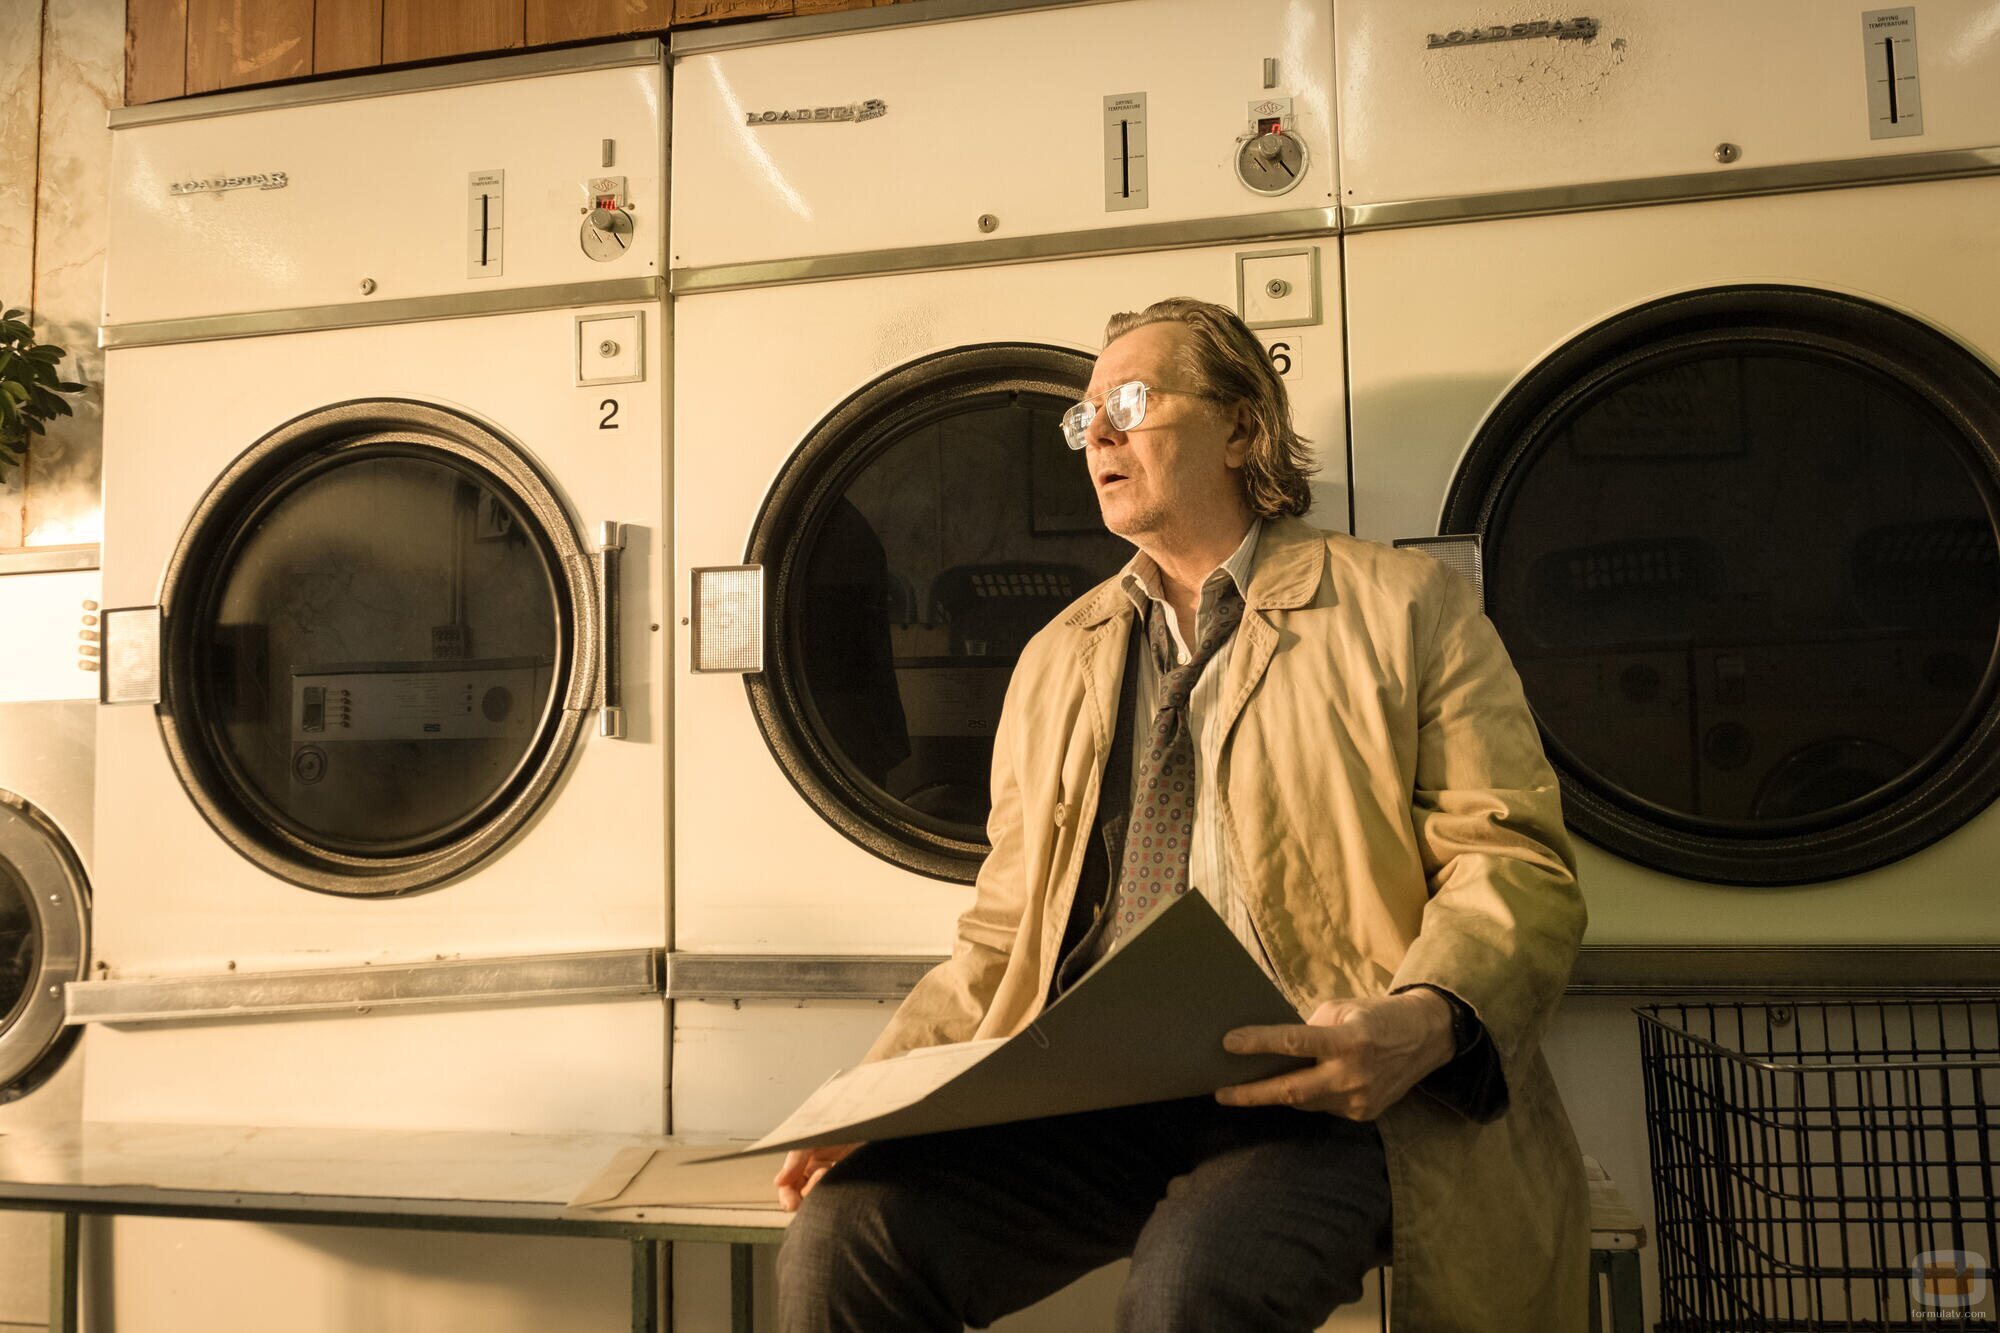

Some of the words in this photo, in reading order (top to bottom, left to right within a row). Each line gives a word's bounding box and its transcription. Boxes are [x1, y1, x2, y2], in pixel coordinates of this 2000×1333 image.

[1427, 16, 1598, 47] LOADSTAR
[1869, 20, 1908, 29] TEMPERATURE
[1269, 342, 1292, 376] 6
[599, 398, 619, 430] 2
